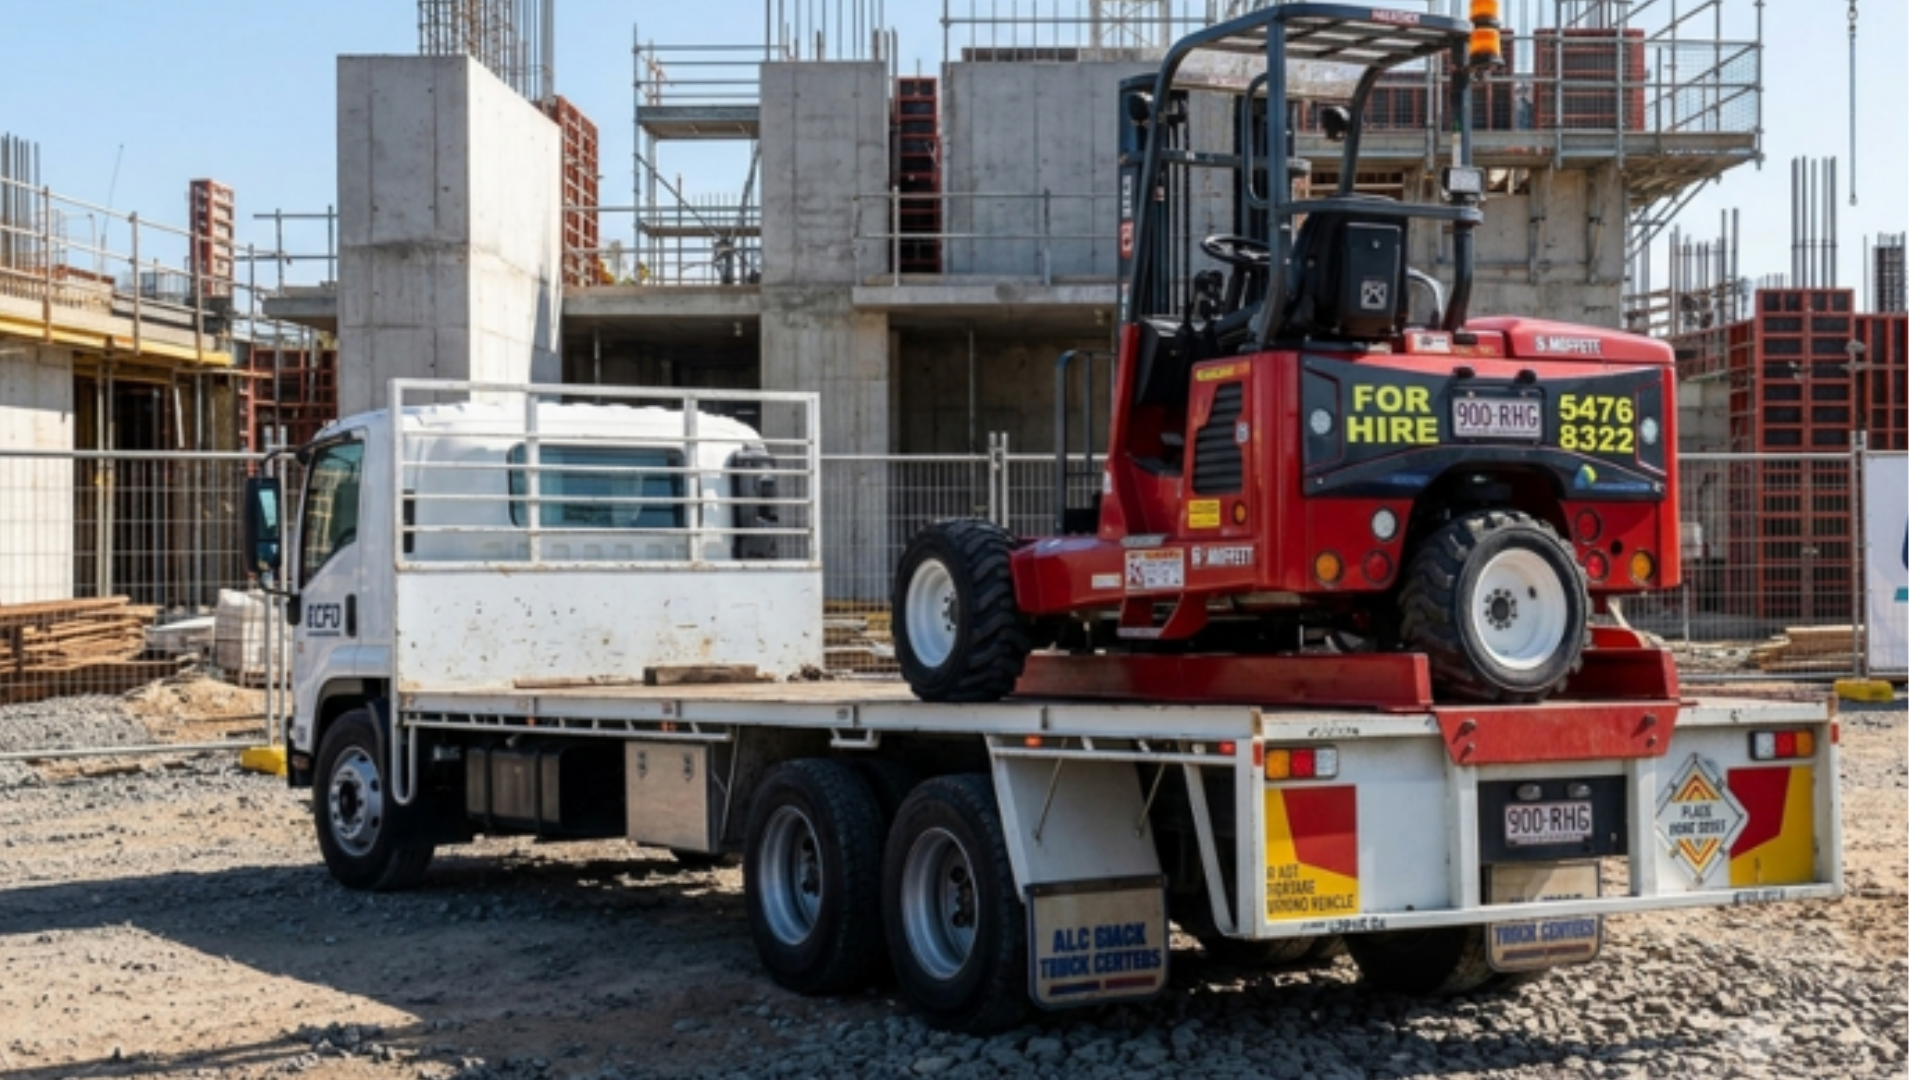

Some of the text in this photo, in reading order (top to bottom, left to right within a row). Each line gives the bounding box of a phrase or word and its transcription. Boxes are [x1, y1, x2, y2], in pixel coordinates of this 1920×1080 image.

[1353, 385, 1431, 413] FOR
[1559, 395, 1635, 424] 5476
[1457, 402, 1539, 428] 900-RHG
[1346, 416, 1440, 444] HIRE
[1559, 424, 1635, 454] 8322
[1508, 808, 1590, 834] 900-RHG
[1053, 927, 1090, 953] ALC
